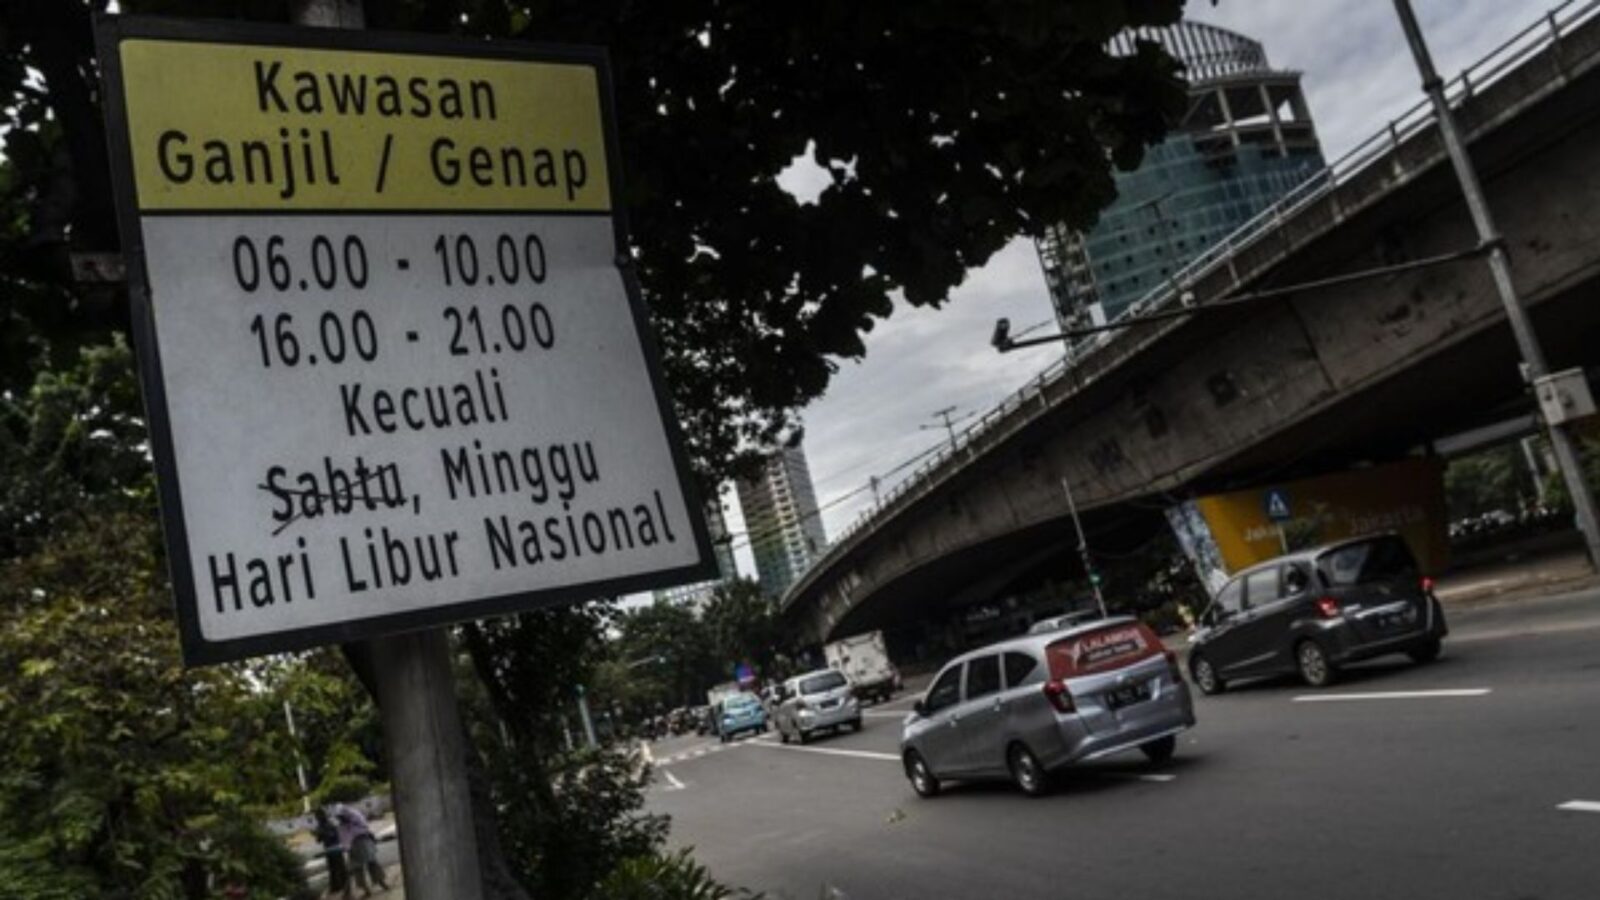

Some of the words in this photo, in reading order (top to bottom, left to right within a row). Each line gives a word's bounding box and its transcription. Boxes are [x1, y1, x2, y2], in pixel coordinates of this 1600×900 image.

[254, 61, 498, 121] Kawasan
[157, 127, 341, 200] Ganjil
[375, 133, 394, 194] /
[429, 137, 588, 202] Genap
[232, 233, 369, 293] 06.00
[397, 258, 411, 271] -
[434, 233, 547, 287] 10.00
[249, 309, 379, 369] 16.00
[405, 330, 420, 343] -
[442, 301, 556, 357] 21.00
[339, 367, 510, 437] Kecuali
[440, 438, 601, 505] Minggu
[208, 536, 316, 613] Hari
[339, 526, 460, 593] Libur
[483, 488, 677, 571] Nasional
